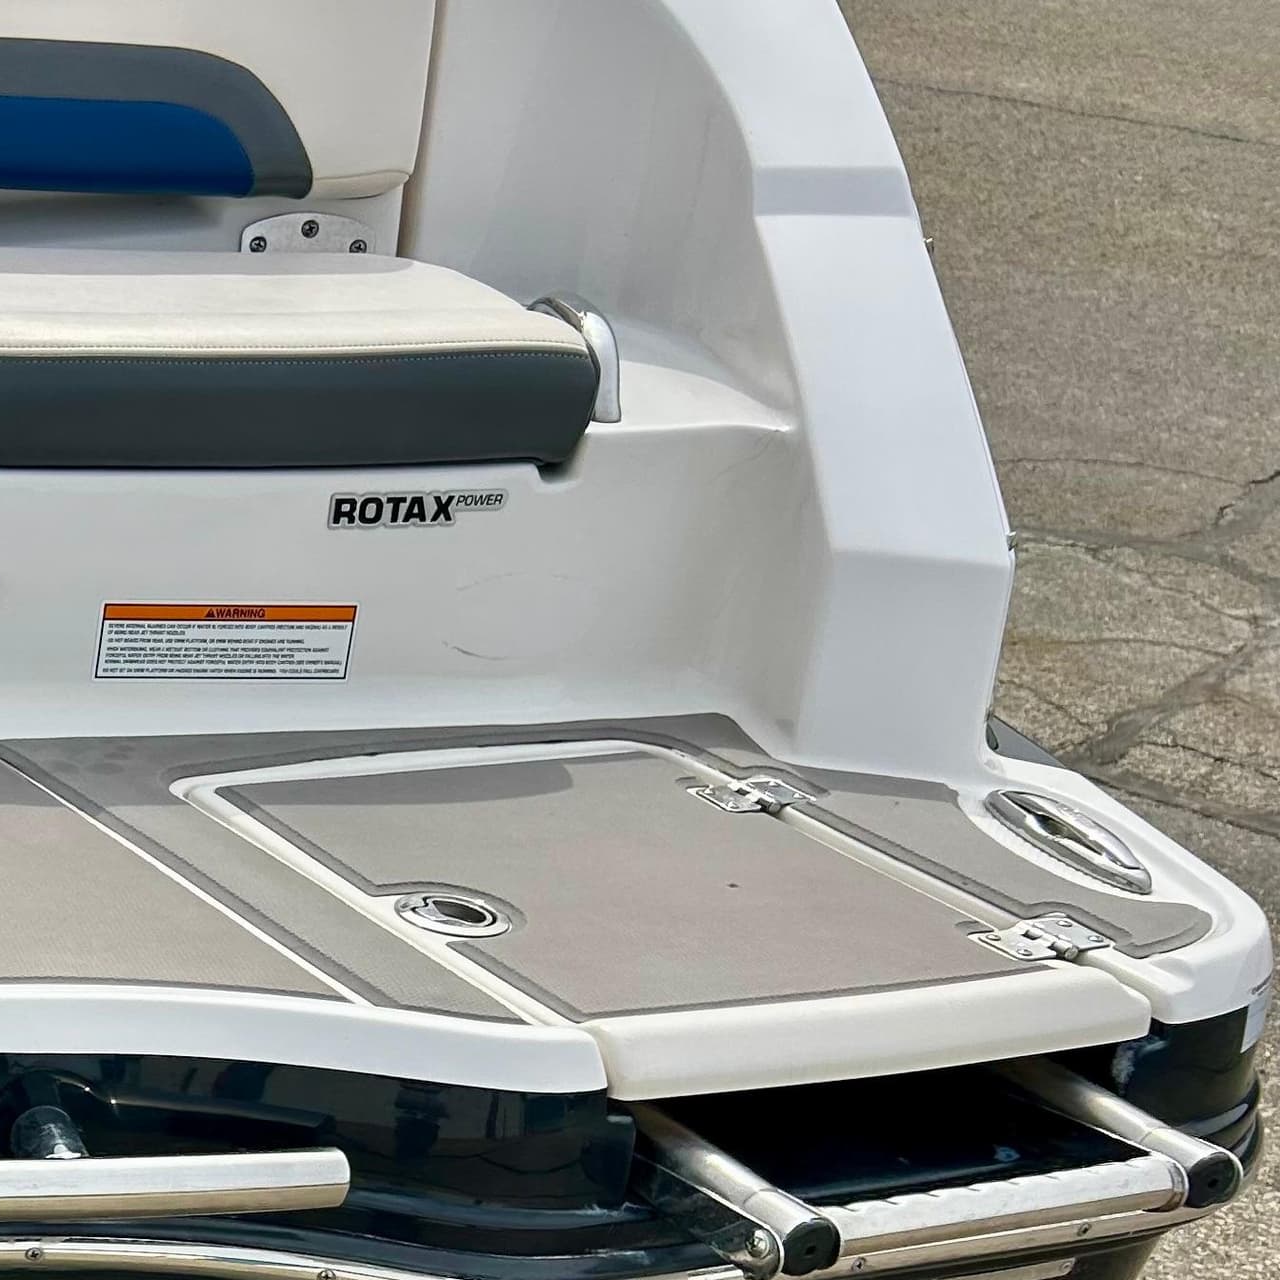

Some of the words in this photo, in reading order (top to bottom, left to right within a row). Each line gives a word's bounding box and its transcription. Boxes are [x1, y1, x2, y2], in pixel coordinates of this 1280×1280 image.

[332, 495, 455, 525] ROTAX
[455, 494, 503, 507] POWER
[215, 607, 266, 619] WARNING
